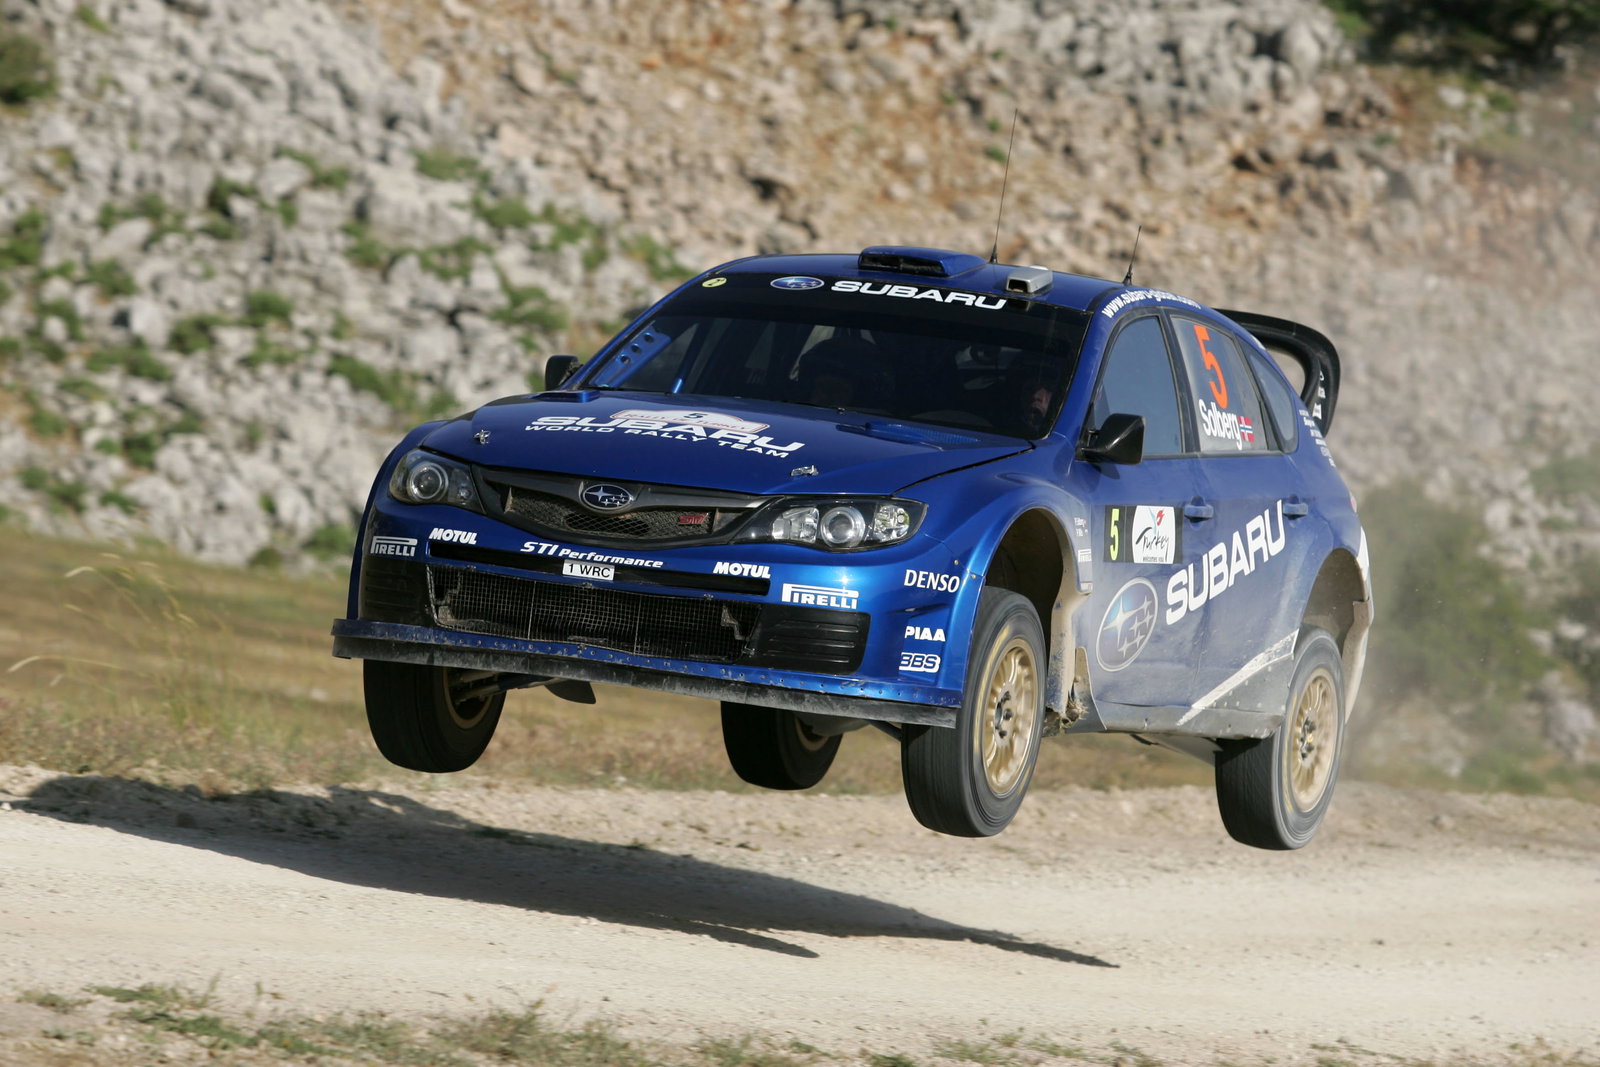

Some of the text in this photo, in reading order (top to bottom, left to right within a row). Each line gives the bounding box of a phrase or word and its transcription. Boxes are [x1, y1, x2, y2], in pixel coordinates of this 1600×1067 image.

[831, 280, 1007, 310] SUBARU
[1193, 325, 1228, 409] 5
[531, 416, 805, 452] SUBARU
[1199, 399, 1243, 451] Solberg
[525, 425, 789, 458] WORLD RALLY TEAM
[370, 535, 418, 557] PIRELLI
[429, 527, 478, 545] MOTUL
[1110, 508, 1120, 561] 5
[520, 541, 664, 568] STI Performance
[1166, 499, 1286, 626] SUBARU
[568, 563, 611, 578] 1 WRC
[713, 561, 771, 579] MOTUL
[904, 569, 960, 593] DENSO
[781, 583, 860, 610] PIRELLI
[904, 625, 946, 642] PIAA
